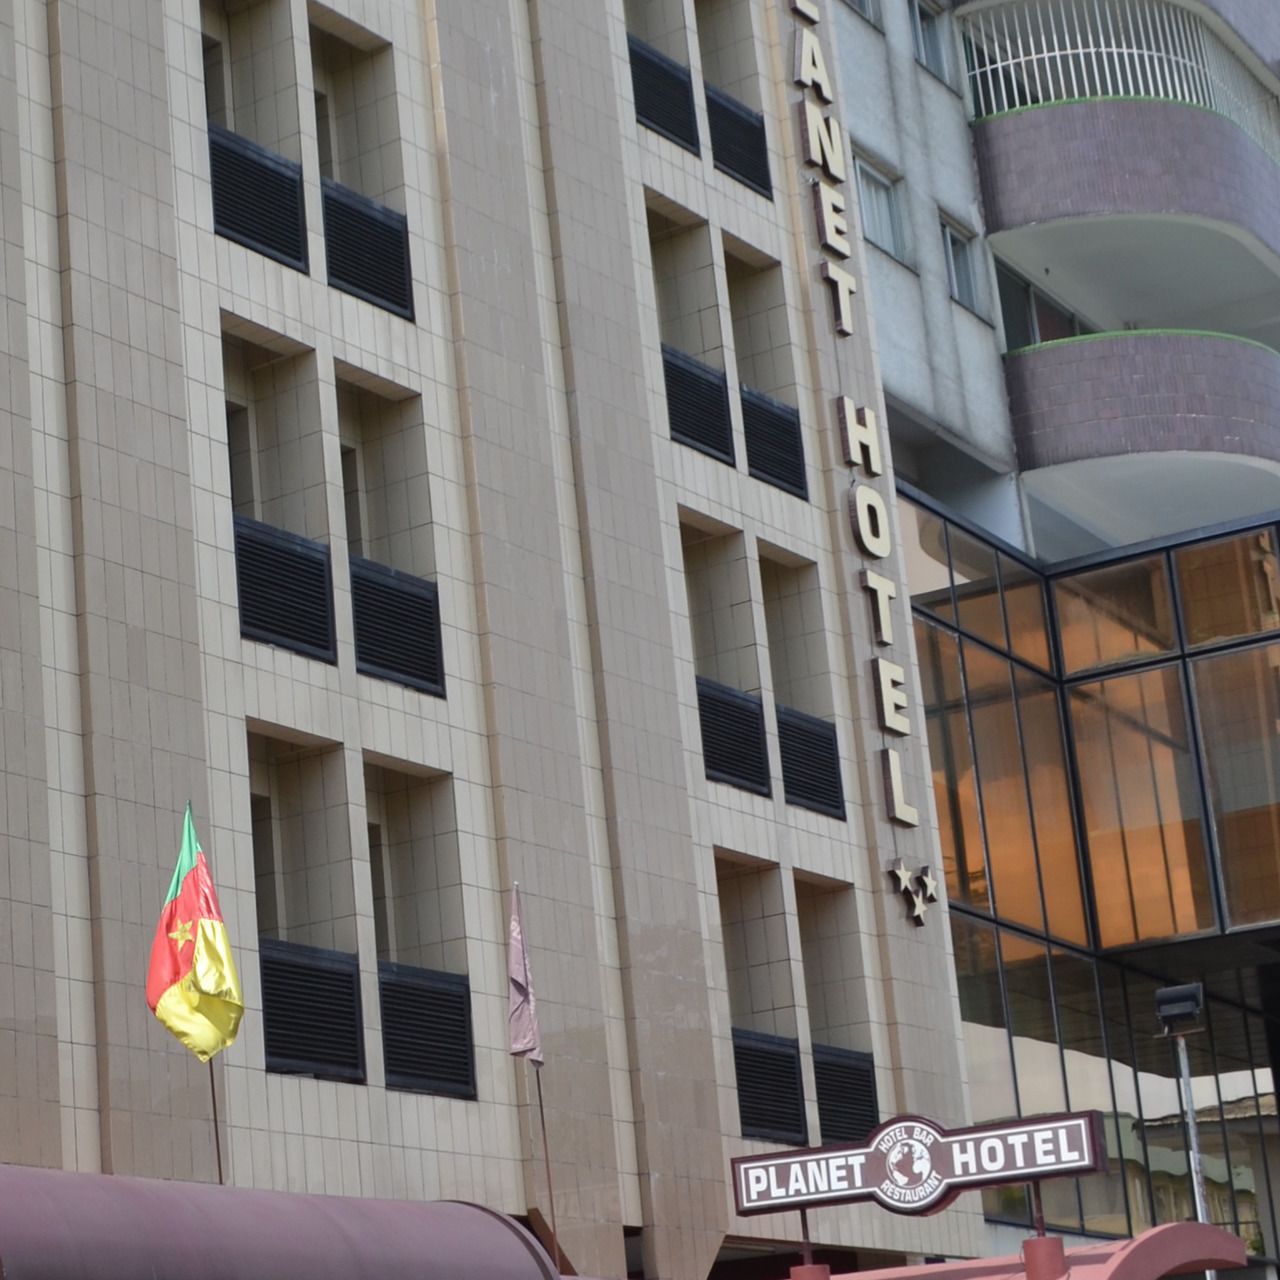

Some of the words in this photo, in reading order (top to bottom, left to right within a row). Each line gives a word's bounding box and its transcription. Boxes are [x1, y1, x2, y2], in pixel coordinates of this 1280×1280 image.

[837, 395, 919, 827] HOTEL
[748, 1154, 867, 1201] PLANET
[952, 1127, 1080, 1176] HOTEL
[878, 1126, 908, 1154] HOTEL
[912, 1126, 935, 1148] BAR
[880, 1170, 942, 1202] RESTAURANT
